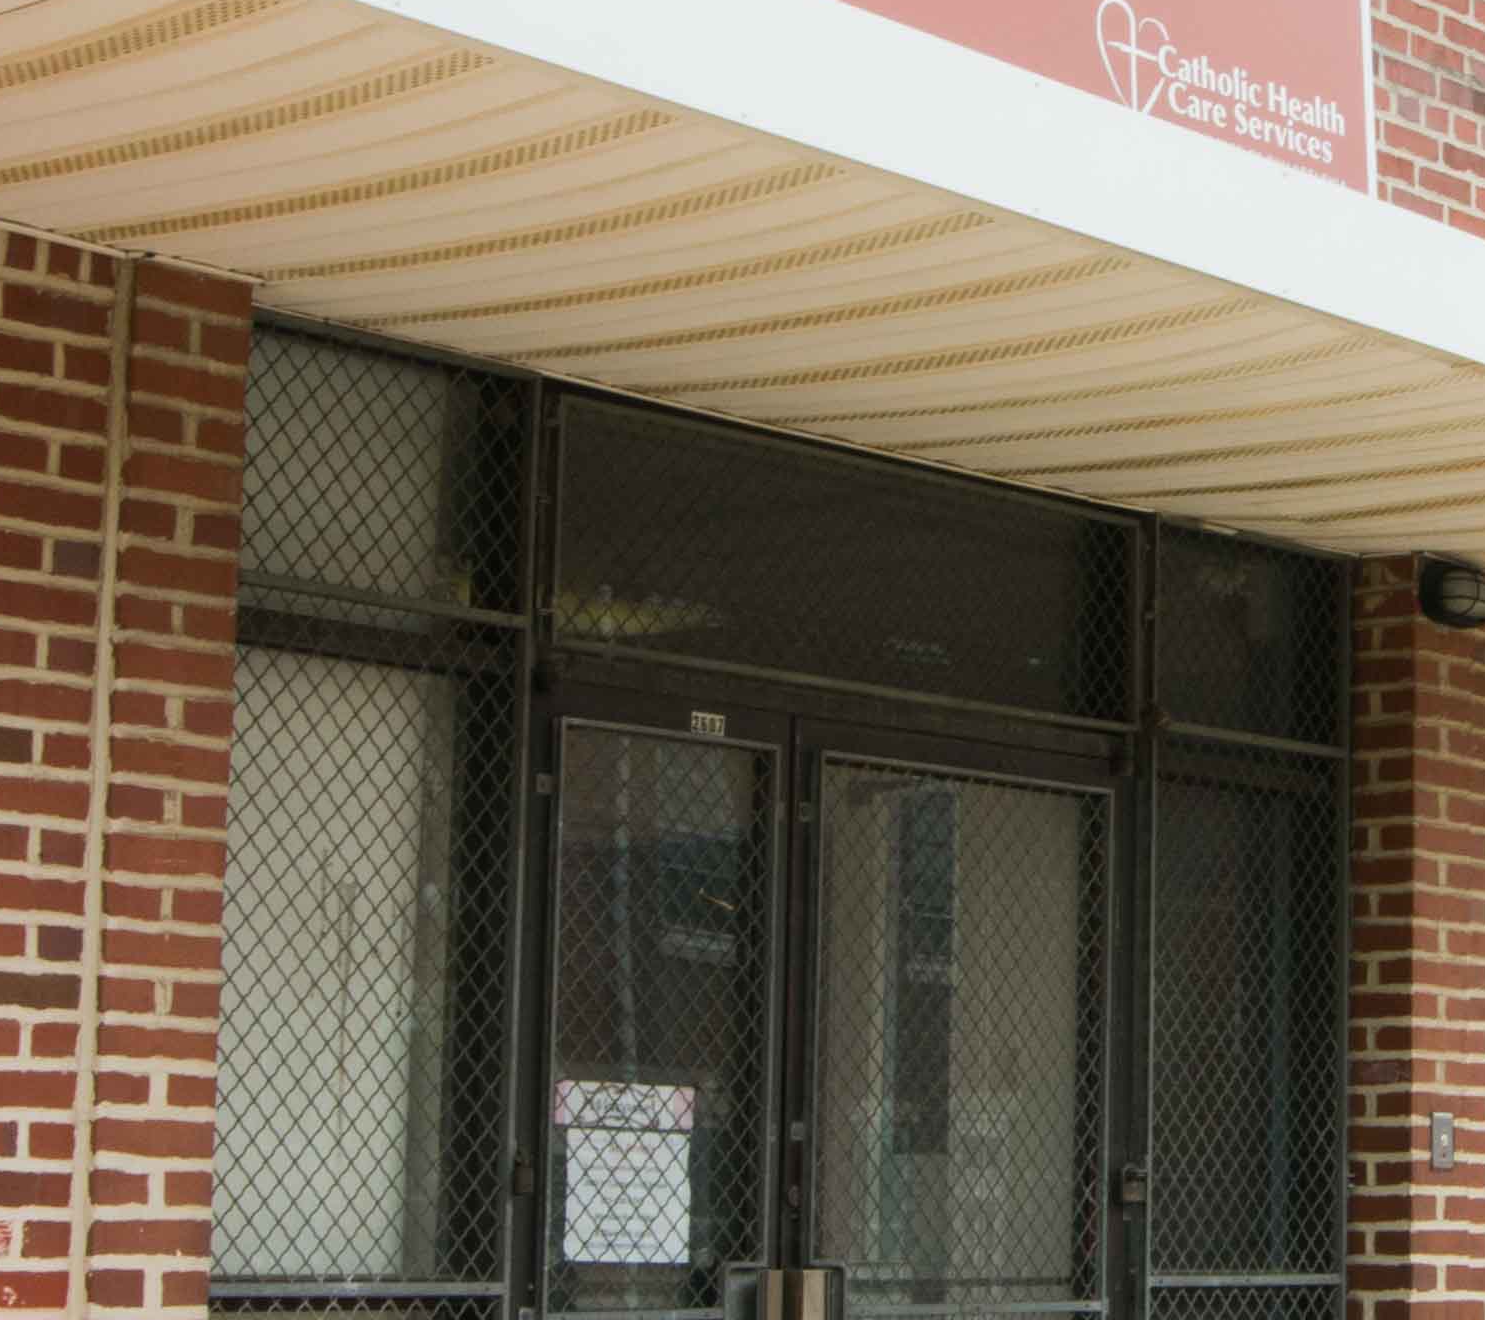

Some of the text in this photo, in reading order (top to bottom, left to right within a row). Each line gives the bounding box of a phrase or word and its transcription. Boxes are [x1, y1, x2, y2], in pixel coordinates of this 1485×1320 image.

[1157, 44, 1345, 137] Catholic Health
[1168, 81, 1332, 163] Care Services
